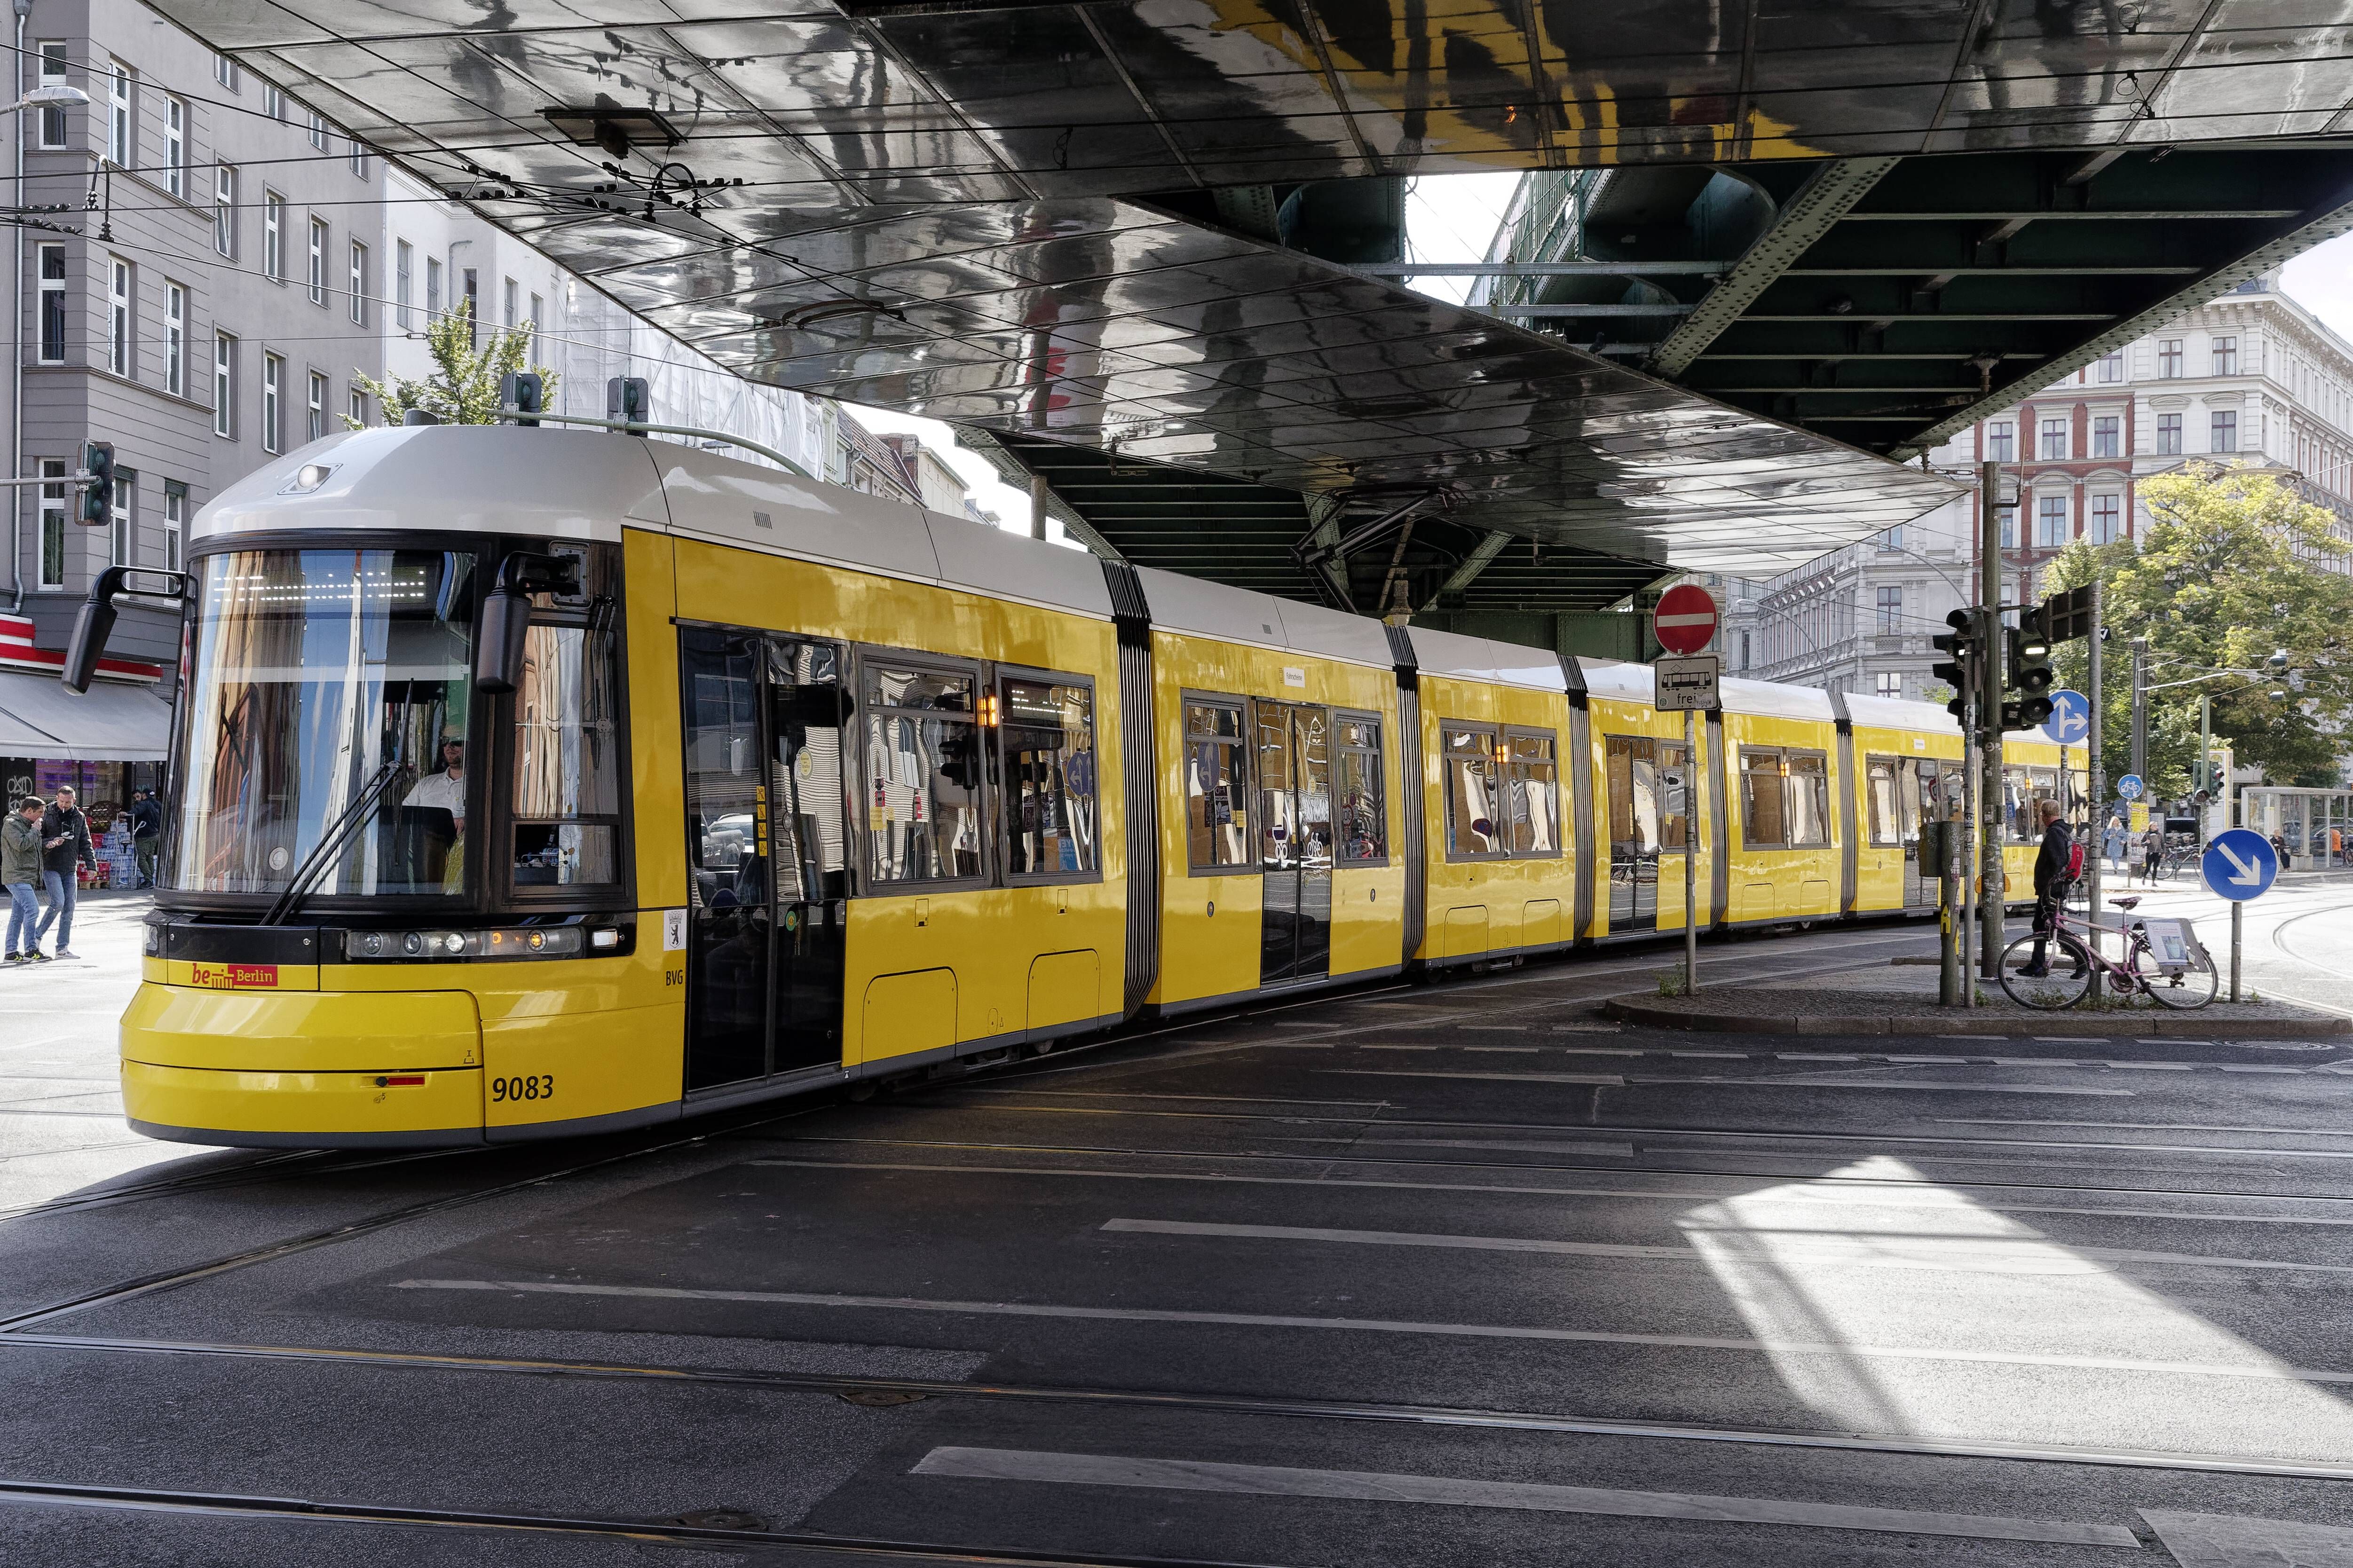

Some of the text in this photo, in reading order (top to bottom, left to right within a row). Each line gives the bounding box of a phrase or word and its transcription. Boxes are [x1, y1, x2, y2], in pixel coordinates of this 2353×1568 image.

[1677, 693, 1696, 704] frei
[192, 962, 273, 984] be Berlin
[666, 969, 683, 986] BVG
[492, 1074, 553, 1103] 9083
